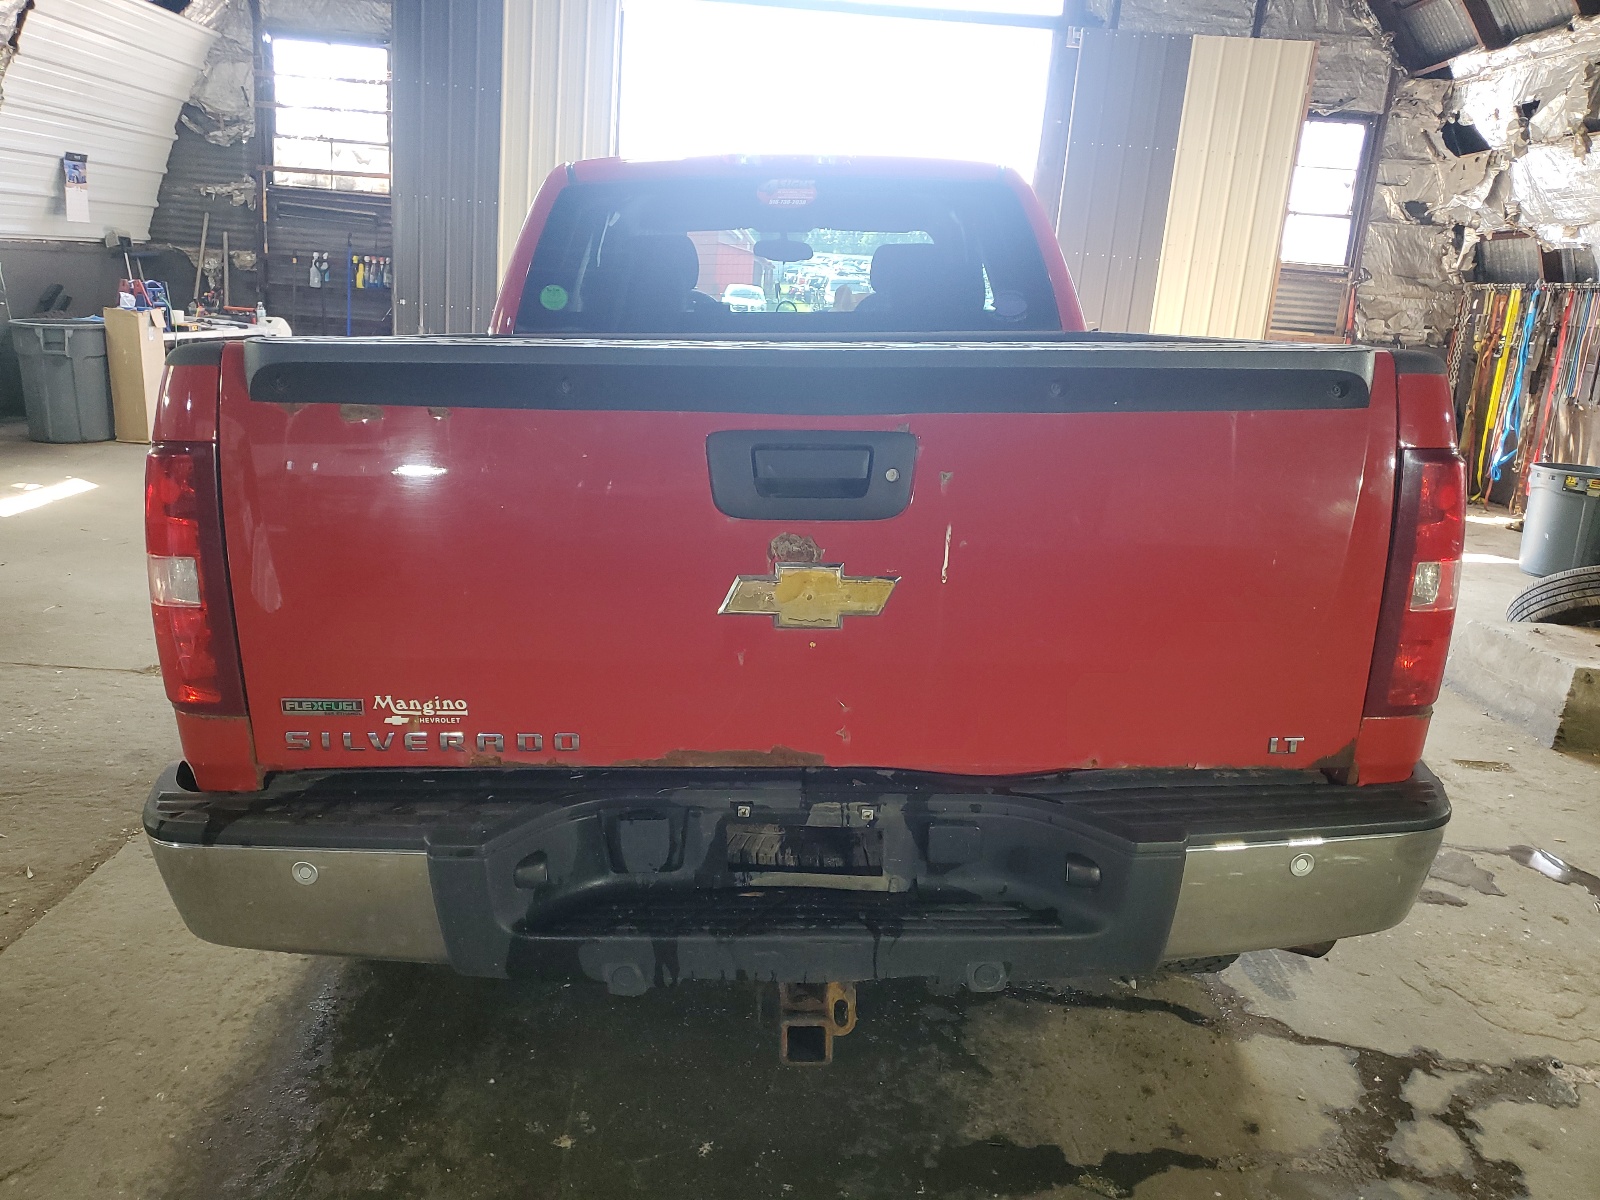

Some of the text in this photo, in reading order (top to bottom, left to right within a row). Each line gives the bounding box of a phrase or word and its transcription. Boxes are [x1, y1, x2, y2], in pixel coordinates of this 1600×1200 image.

[285, 701, 362, 711] FLEXFUEL
[372, 695, 468, 716] Mangino
[284, 731, 580, 752] SILVERADO
[1268, 736, 1305, 754] LT
